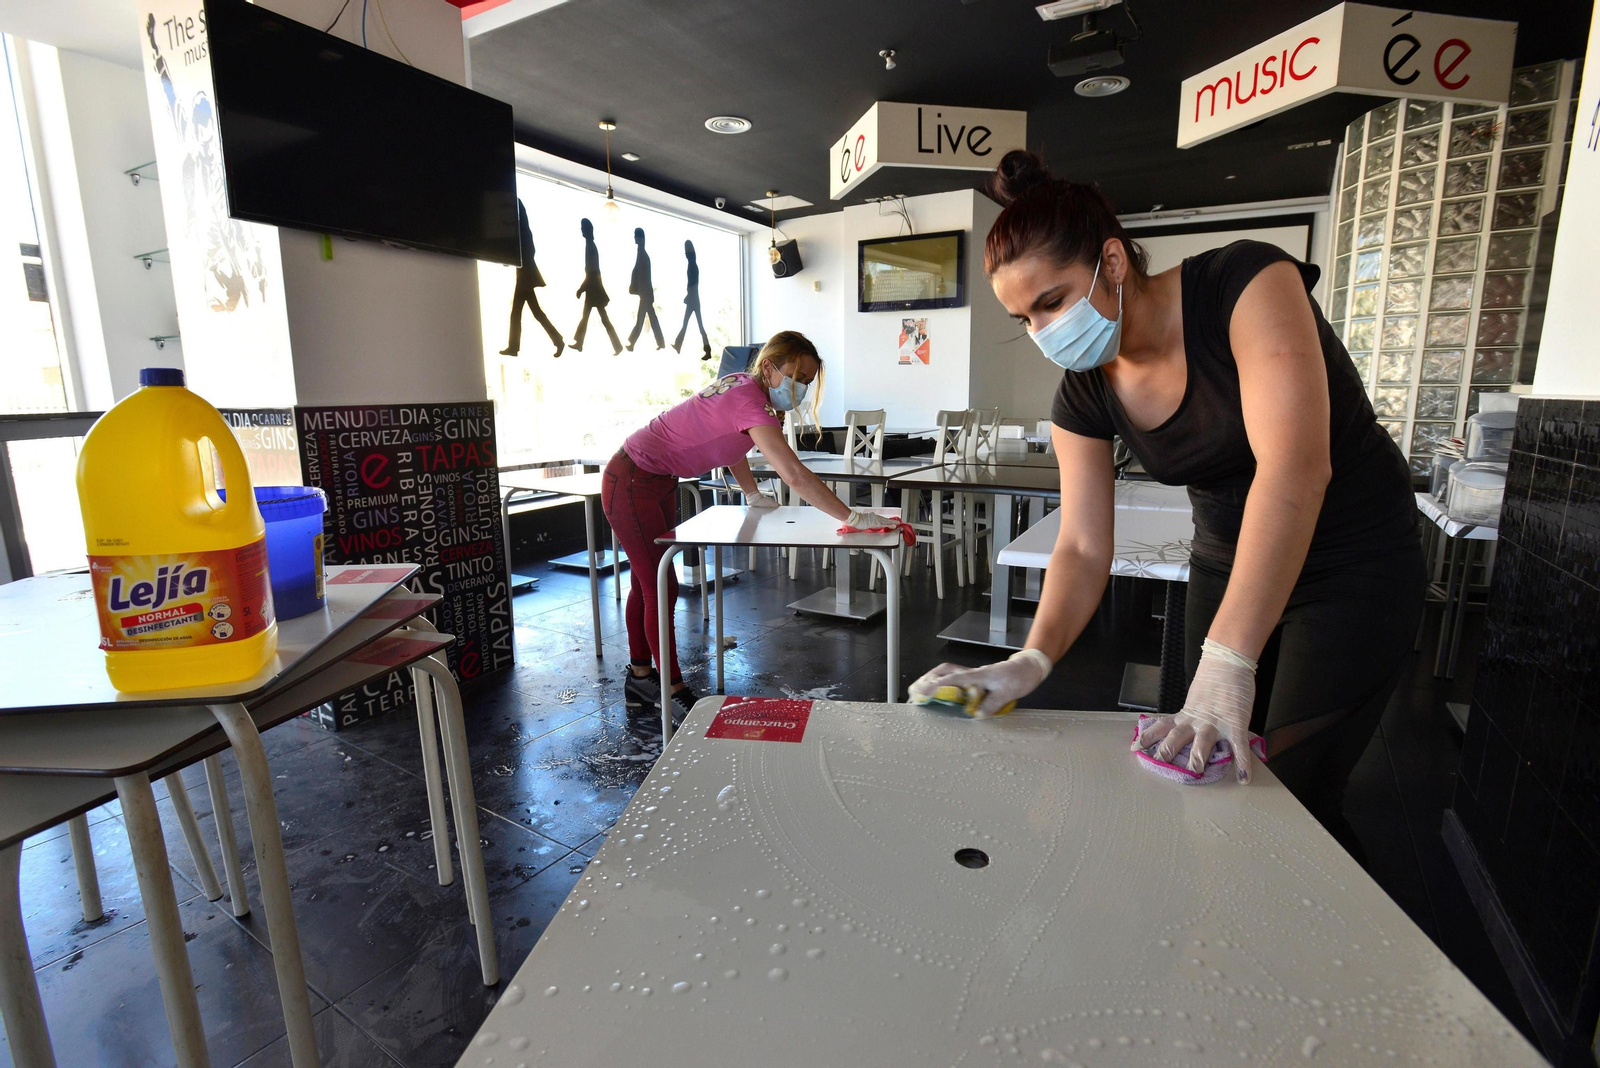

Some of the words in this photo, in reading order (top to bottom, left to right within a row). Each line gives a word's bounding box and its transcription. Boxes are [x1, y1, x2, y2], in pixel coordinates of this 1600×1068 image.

[163, 15, 195, 51] The
[184, 40, 208, 67] mus
[1434, 38, 1472, 91] e
[1194, 36, 1321, 123] music
[917, 107, 992, 157] Live
[854, 134, 866, 172] e
[432, 408, 443, 442] CAVA
[442, 406, 490, 418] CARNES
[444, 417, 492, 439] GINS
[260, 426, 297, 451] GINS
[338, 429, 413, 449] CERVEZA
[411, 431, 435, 443] GINS
[360, 453, 392, 489] e
[415, 440, 496, 473] TAPAS
[343, 451, 360, 497] RIOJA
[433, 472, 461, 484] VINOS
[347, 493, 399, 510] PREMIUM
[397, 452, 420, 541] RIBERA
[435, 487, 448, 530] CAVA
[447, 484, 458, 528] COCKTAILS
[462, 470, 478, 523] RIOJA
[476, 468, 493, 540] FUTBOL
[352, 506, 400, 529] GINS
[417, 473, 440, 567] RACIONES
[338, 526, 402, 555] VINOS
[439, 524, 481, 547] GINS
[440, 540, 494, 563] CERVEZA
[445, 555, 494, 580] TINTO
[110, 564, 208, 611] Lejía
[126, 614, 198, 636] DESINFECTANTE
[138, 607, 187, 623] NORMAL
[453, 595, 466, 647] RACIONES
[465, 592, 477, 636] FUTBOL
[487, 582, 512, 670] TAPAS
[723, 718, 797, 730] Cruzcampo
